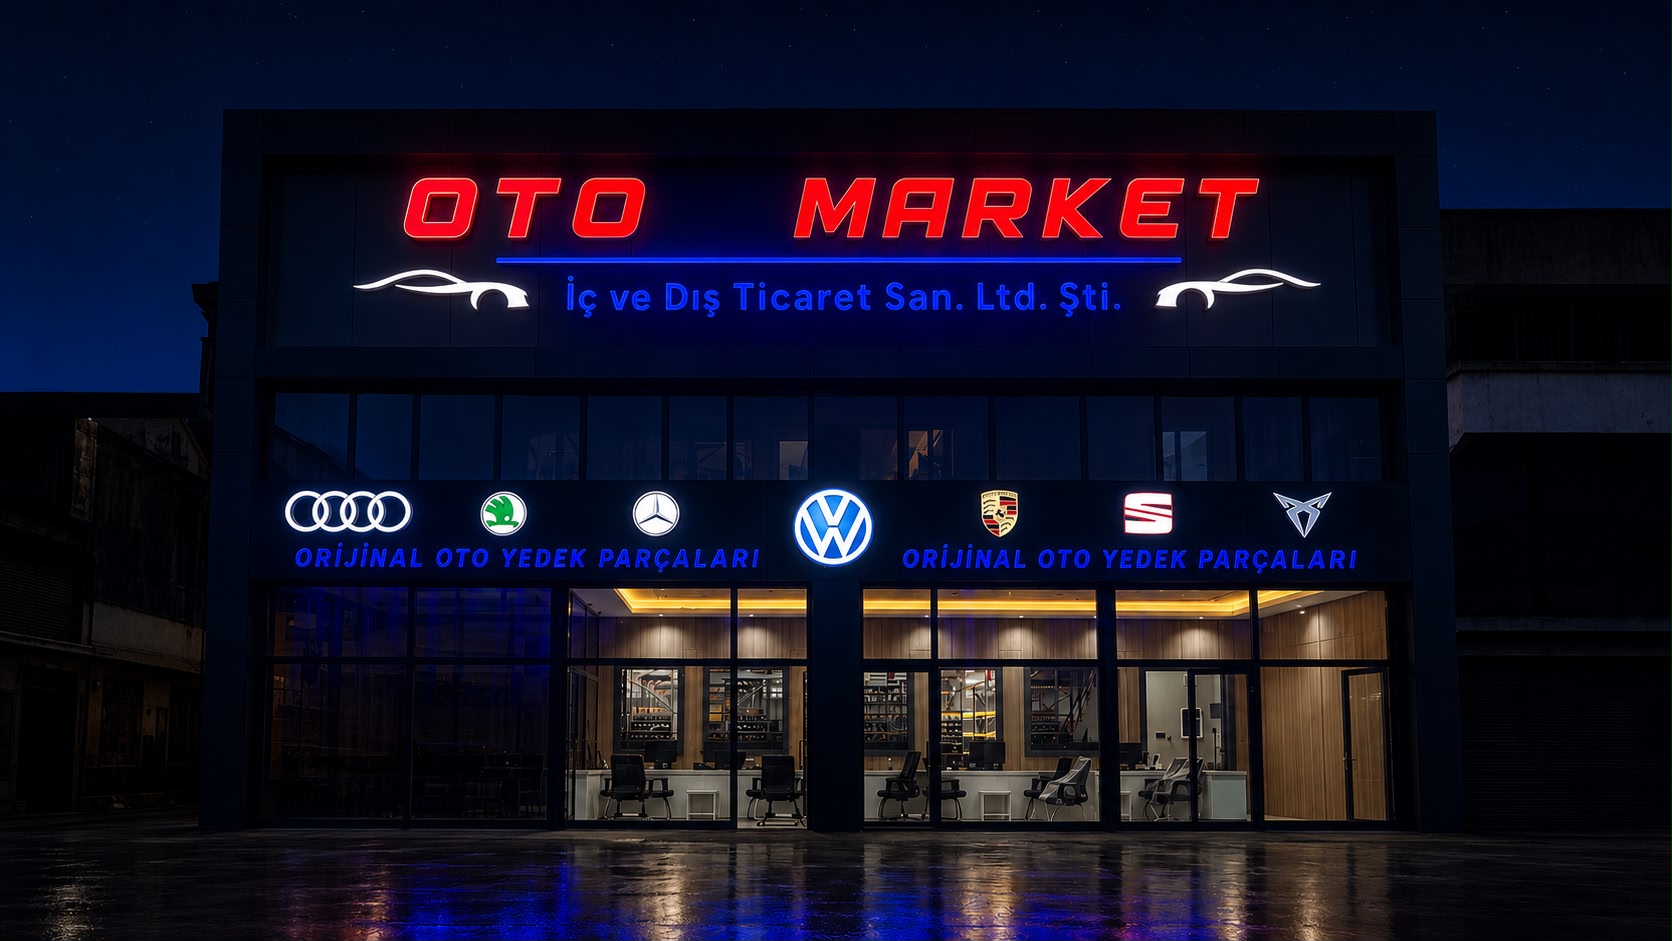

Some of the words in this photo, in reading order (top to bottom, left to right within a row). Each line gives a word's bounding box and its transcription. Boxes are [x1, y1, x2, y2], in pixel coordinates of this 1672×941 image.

[403, 177, 646, 239] OTO
[793, 177, 1260, 239] MARKET
[566, 275, 597, 318] İç
[609, 289, 651, 312] ve
[665, 282, 721, 318] Dış
[732, 281, 871, 312] Ticaret
[885, 281, 963, 312] San.
[977, 281, 1047, 312] Ltd.
[1059, 281, 1121, 318] Şti.
[294, 541, 423, 569] ORİJİNAL
[435, 547, 489, 569] OTO
[501, 547, 587, 569] YEDEK
[598, 547, 760, 573] PARÇALARI
[902, 543, 1026, 570] ORİJİNAL
[1037, 548, 1091, 570] OTO
[1102, 548, 1187, 570] YEDEK
[1198, 548, 1358, 575] PARÇALARI
